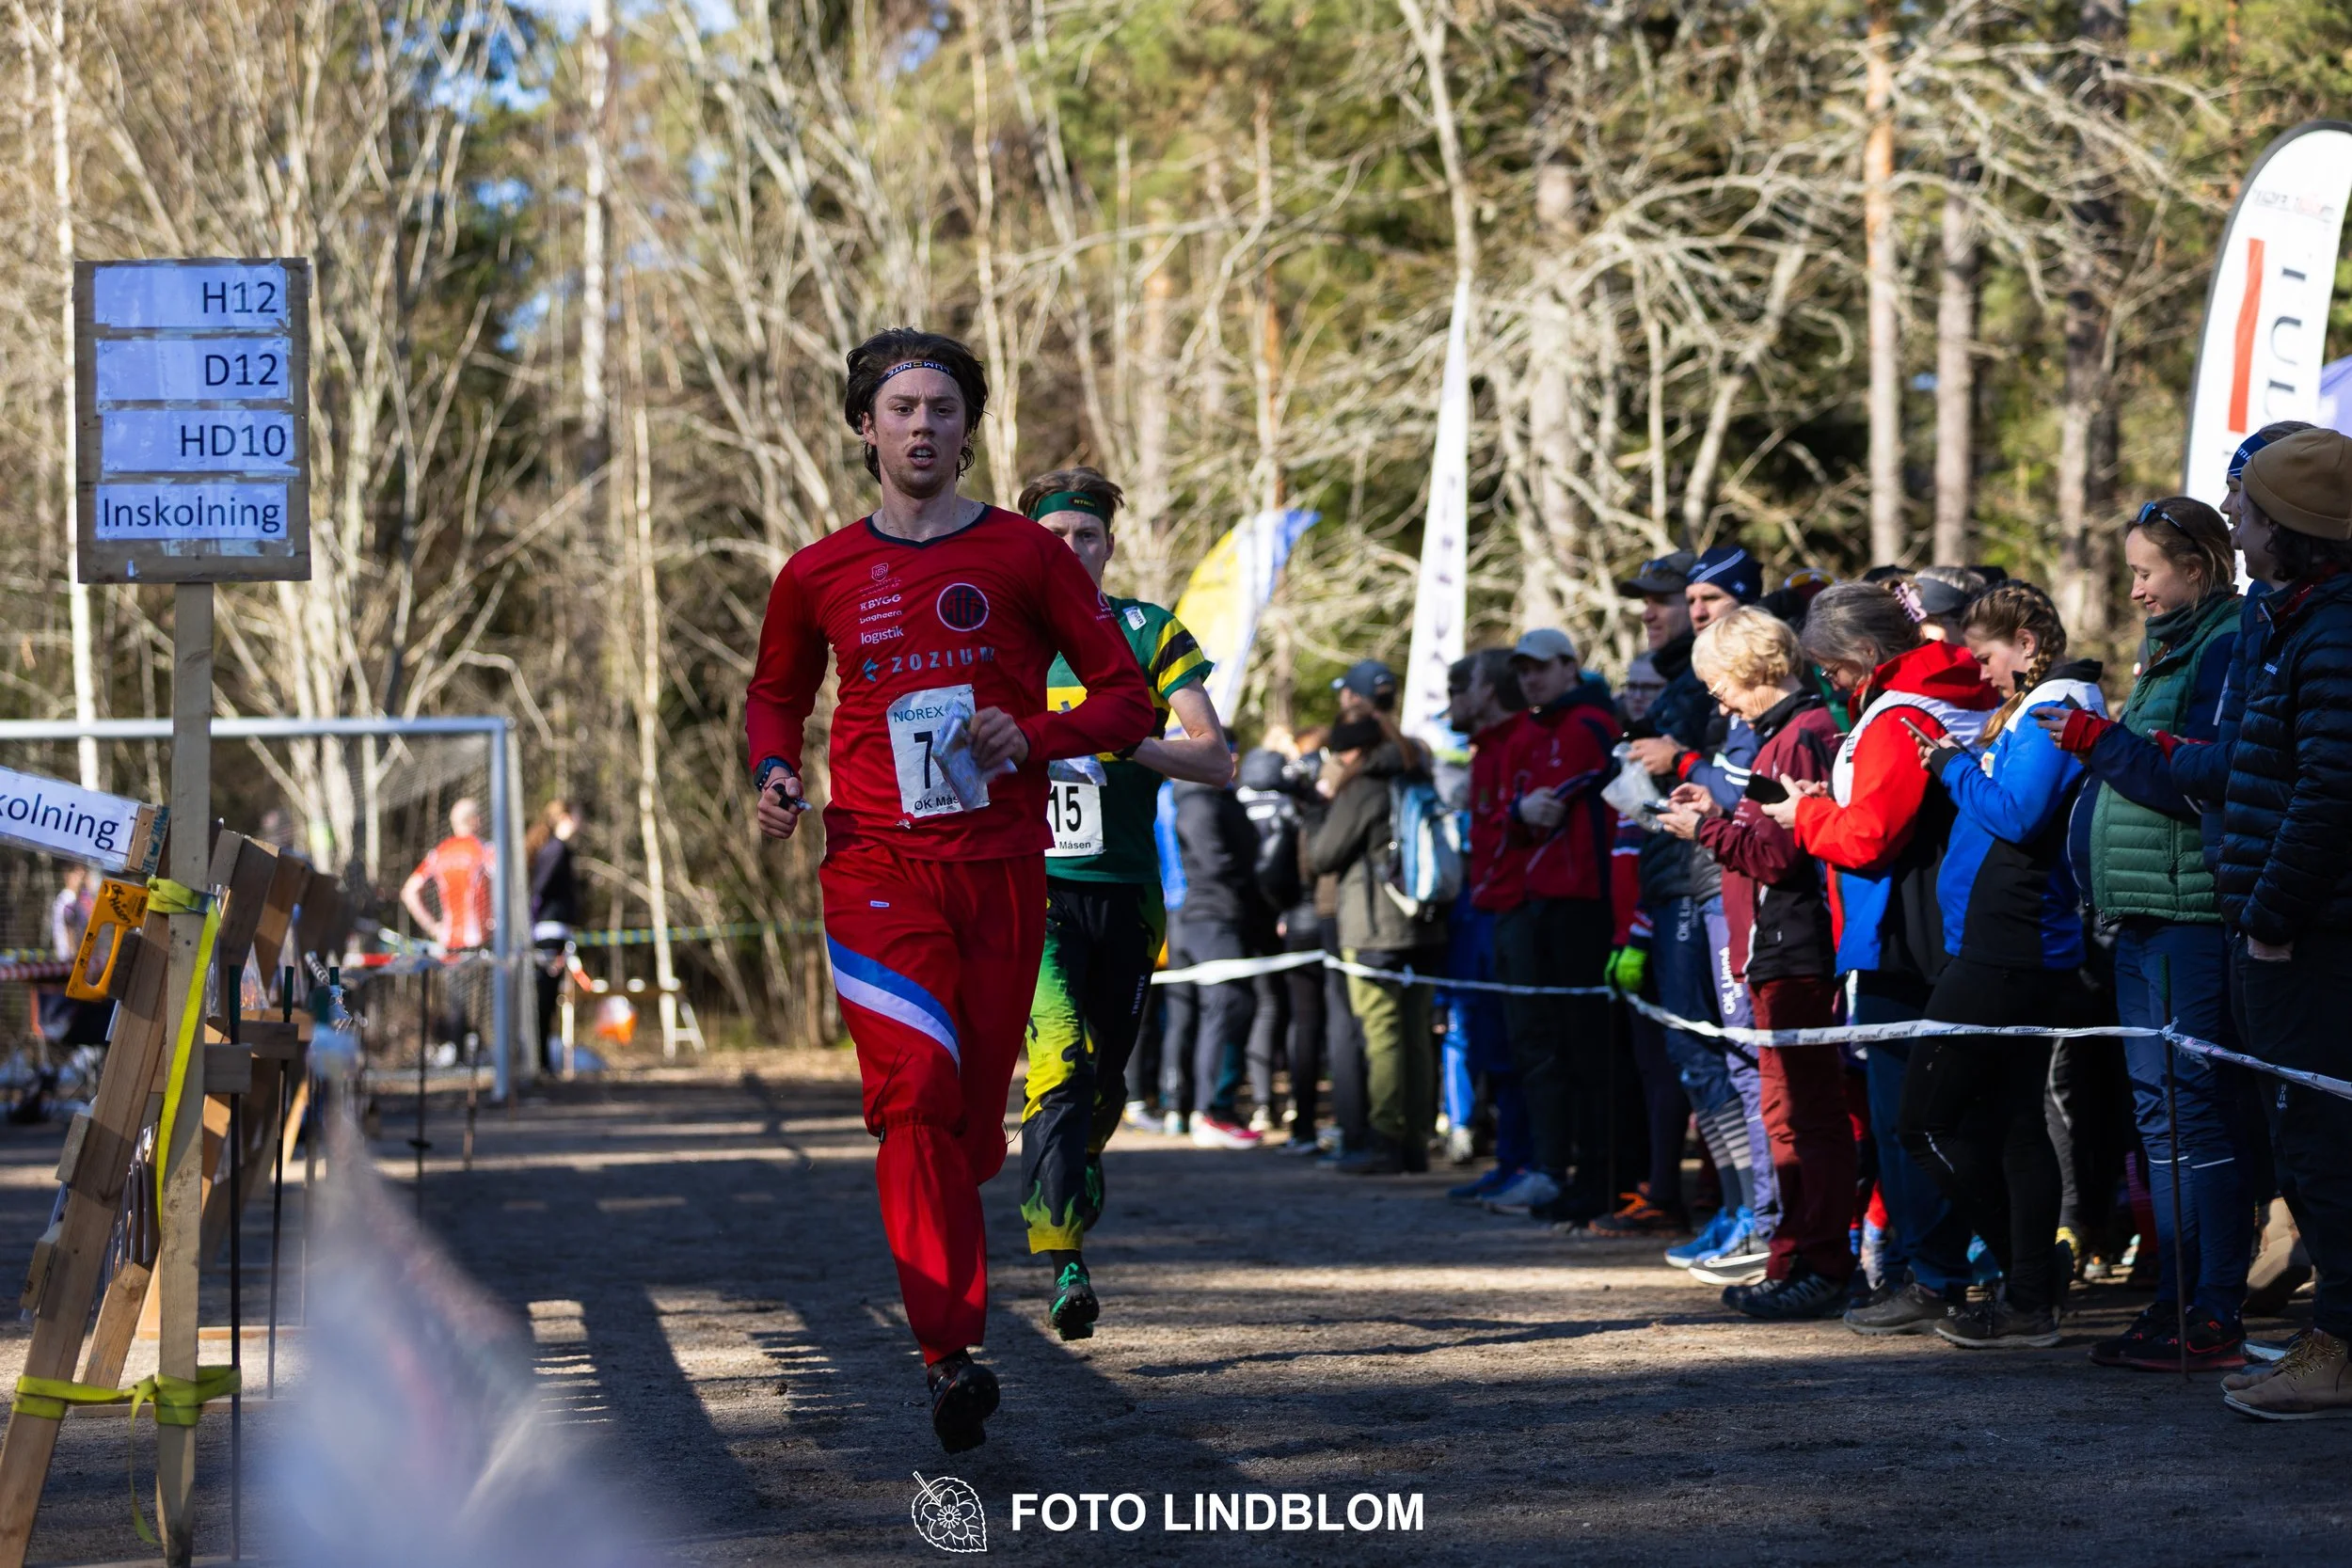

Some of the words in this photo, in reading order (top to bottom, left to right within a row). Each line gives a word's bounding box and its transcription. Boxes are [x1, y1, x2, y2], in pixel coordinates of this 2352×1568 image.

[203, 281, 278, 313] H12
[205, 354, 278, 387] D12
[181, 424, 286, 457] HD10
[103, 496, 280, 533] Inskolning
[861, 626, 904, 645] logistik
[891, 647, 994, 673] ZOZIUM
[894, 705, 944, 722] NOREX
[914, 730, 940, 789] 7
[914, 799, 932, 811] OK
[936, 796, 960, 807] Mås
[1049, 785, 1082, 832] 15
[1059, 841, 1091, 849] Måsen
[1677, 919, 1691, 942] OK
[1132, 974, 1147, 1015] TRIMTEX
[1723, 990, 1737, 1015] OK
